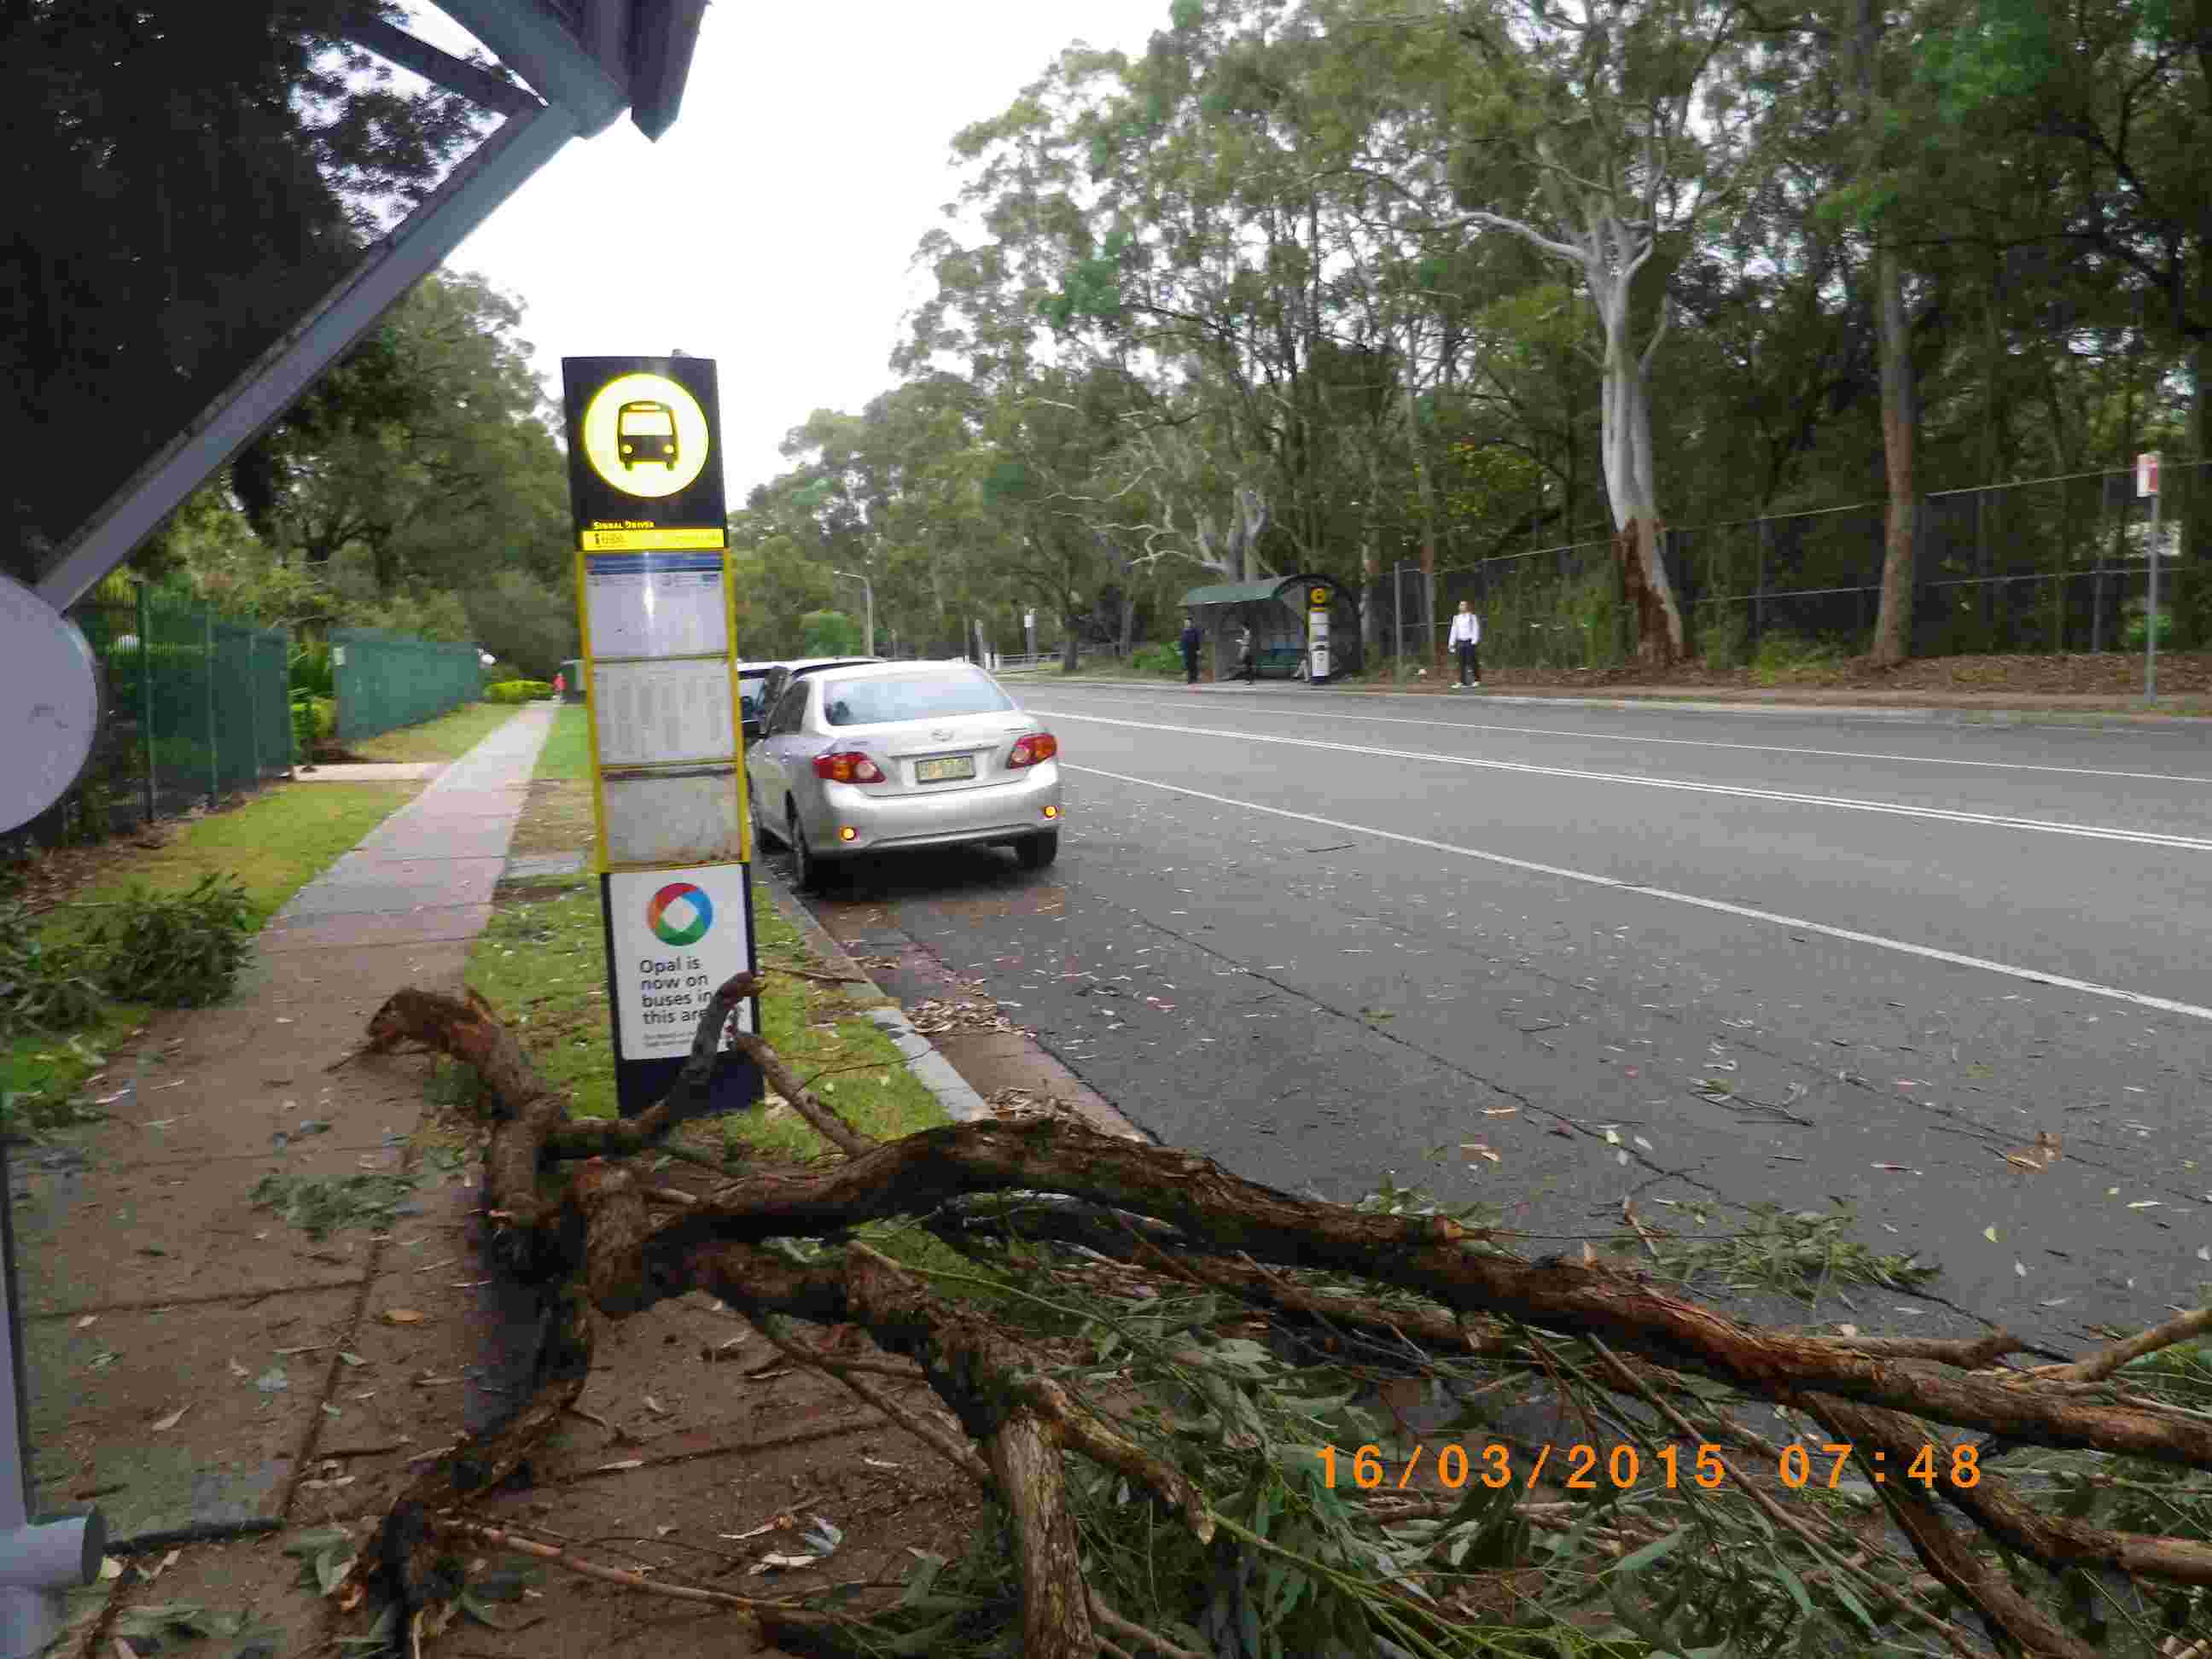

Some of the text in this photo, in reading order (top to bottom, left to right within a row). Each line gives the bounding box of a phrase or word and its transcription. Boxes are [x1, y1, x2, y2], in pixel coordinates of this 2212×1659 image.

[640, 956, 701, 975] Opal is
[642, 975, 709, 990] now on
[642, 990, 712, 1008] buses in
[642, 1010, 677, 1025] this
